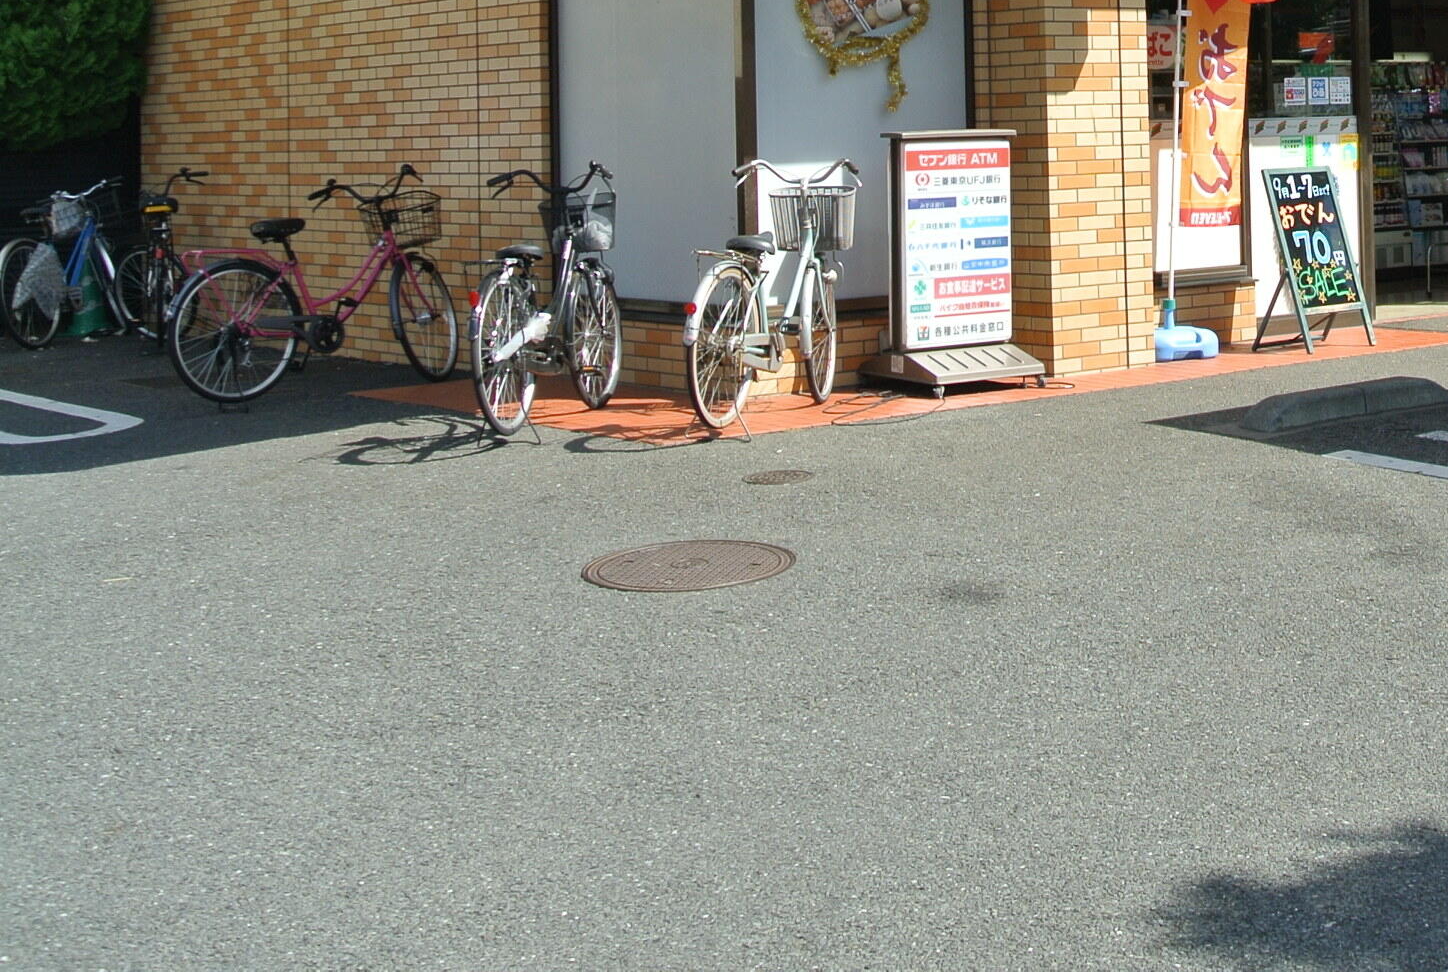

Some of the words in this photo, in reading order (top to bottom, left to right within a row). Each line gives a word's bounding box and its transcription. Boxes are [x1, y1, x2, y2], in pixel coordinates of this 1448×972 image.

[918, 154, 967, 168] セブン銀行
[970, 152, 998, 165] ATM
[933, 174, 1001, 187] 三菱東京UFJ銀行
[971, 195, 1007, 205] りそな銀行
[1279, 202, 1336, 230] おでん
[1292, 230, 1346, 266] 70円
[1298, 266, 1349, 300] SALE
[935, 321, 1005, 338] 各種公共料金窓口
